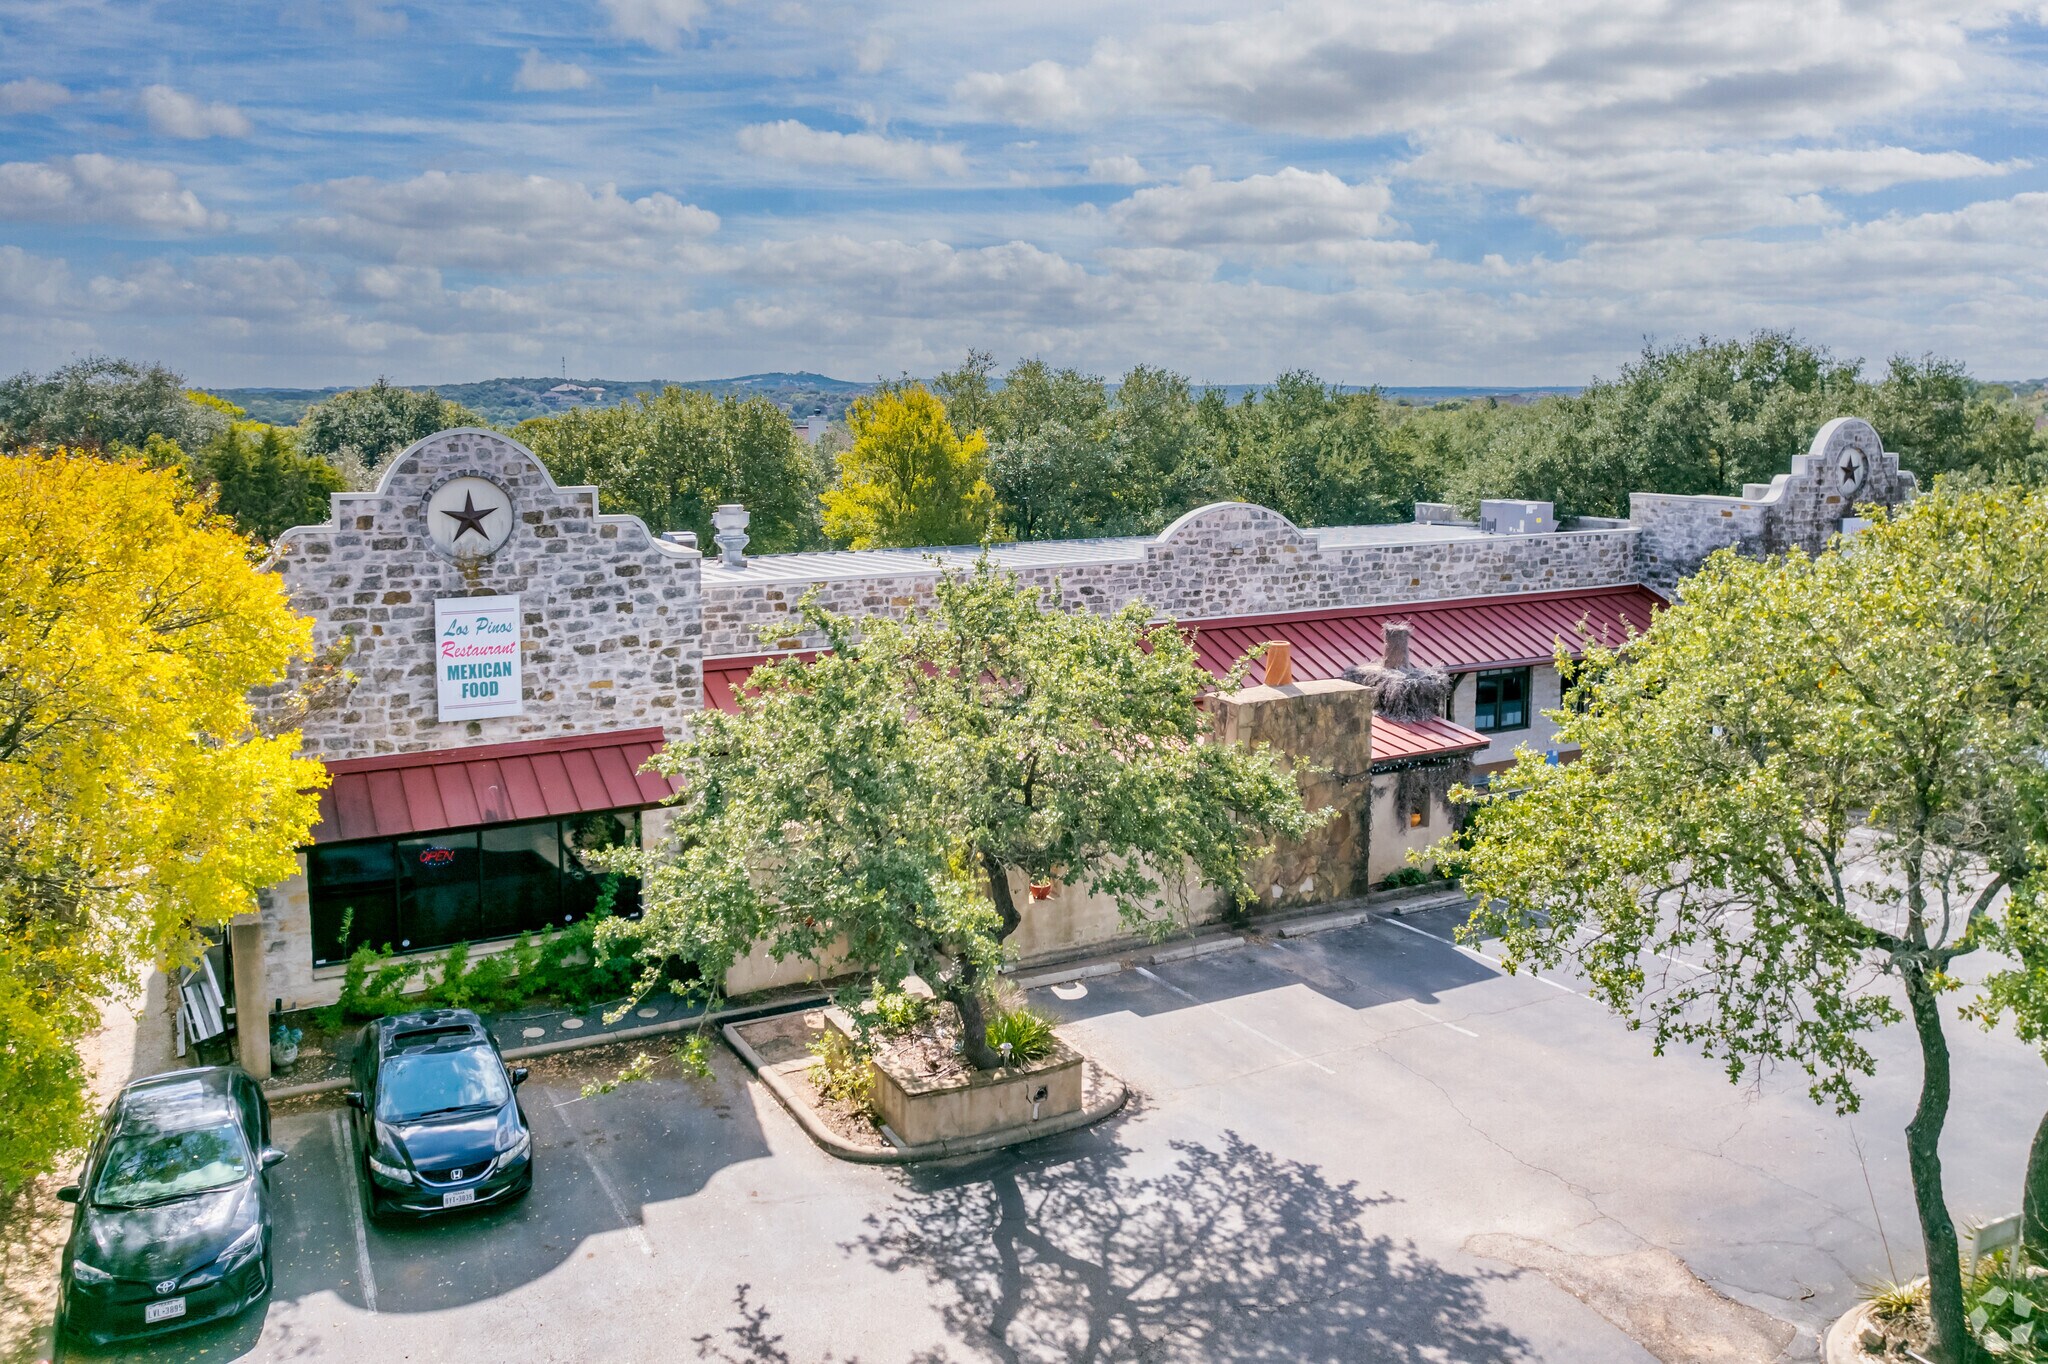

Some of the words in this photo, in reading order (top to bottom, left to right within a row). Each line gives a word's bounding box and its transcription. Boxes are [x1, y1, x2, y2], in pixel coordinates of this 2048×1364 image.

[443, 618, 469, 637] Los
[476, 617, 513, 635] Pinos
[441, 641, 516, 659] Restaurant
[447, 661, 512, 681] MEXICAN
[462, 681, 499, 699] FOOD
[420, 850, 455, 863] OPEN
